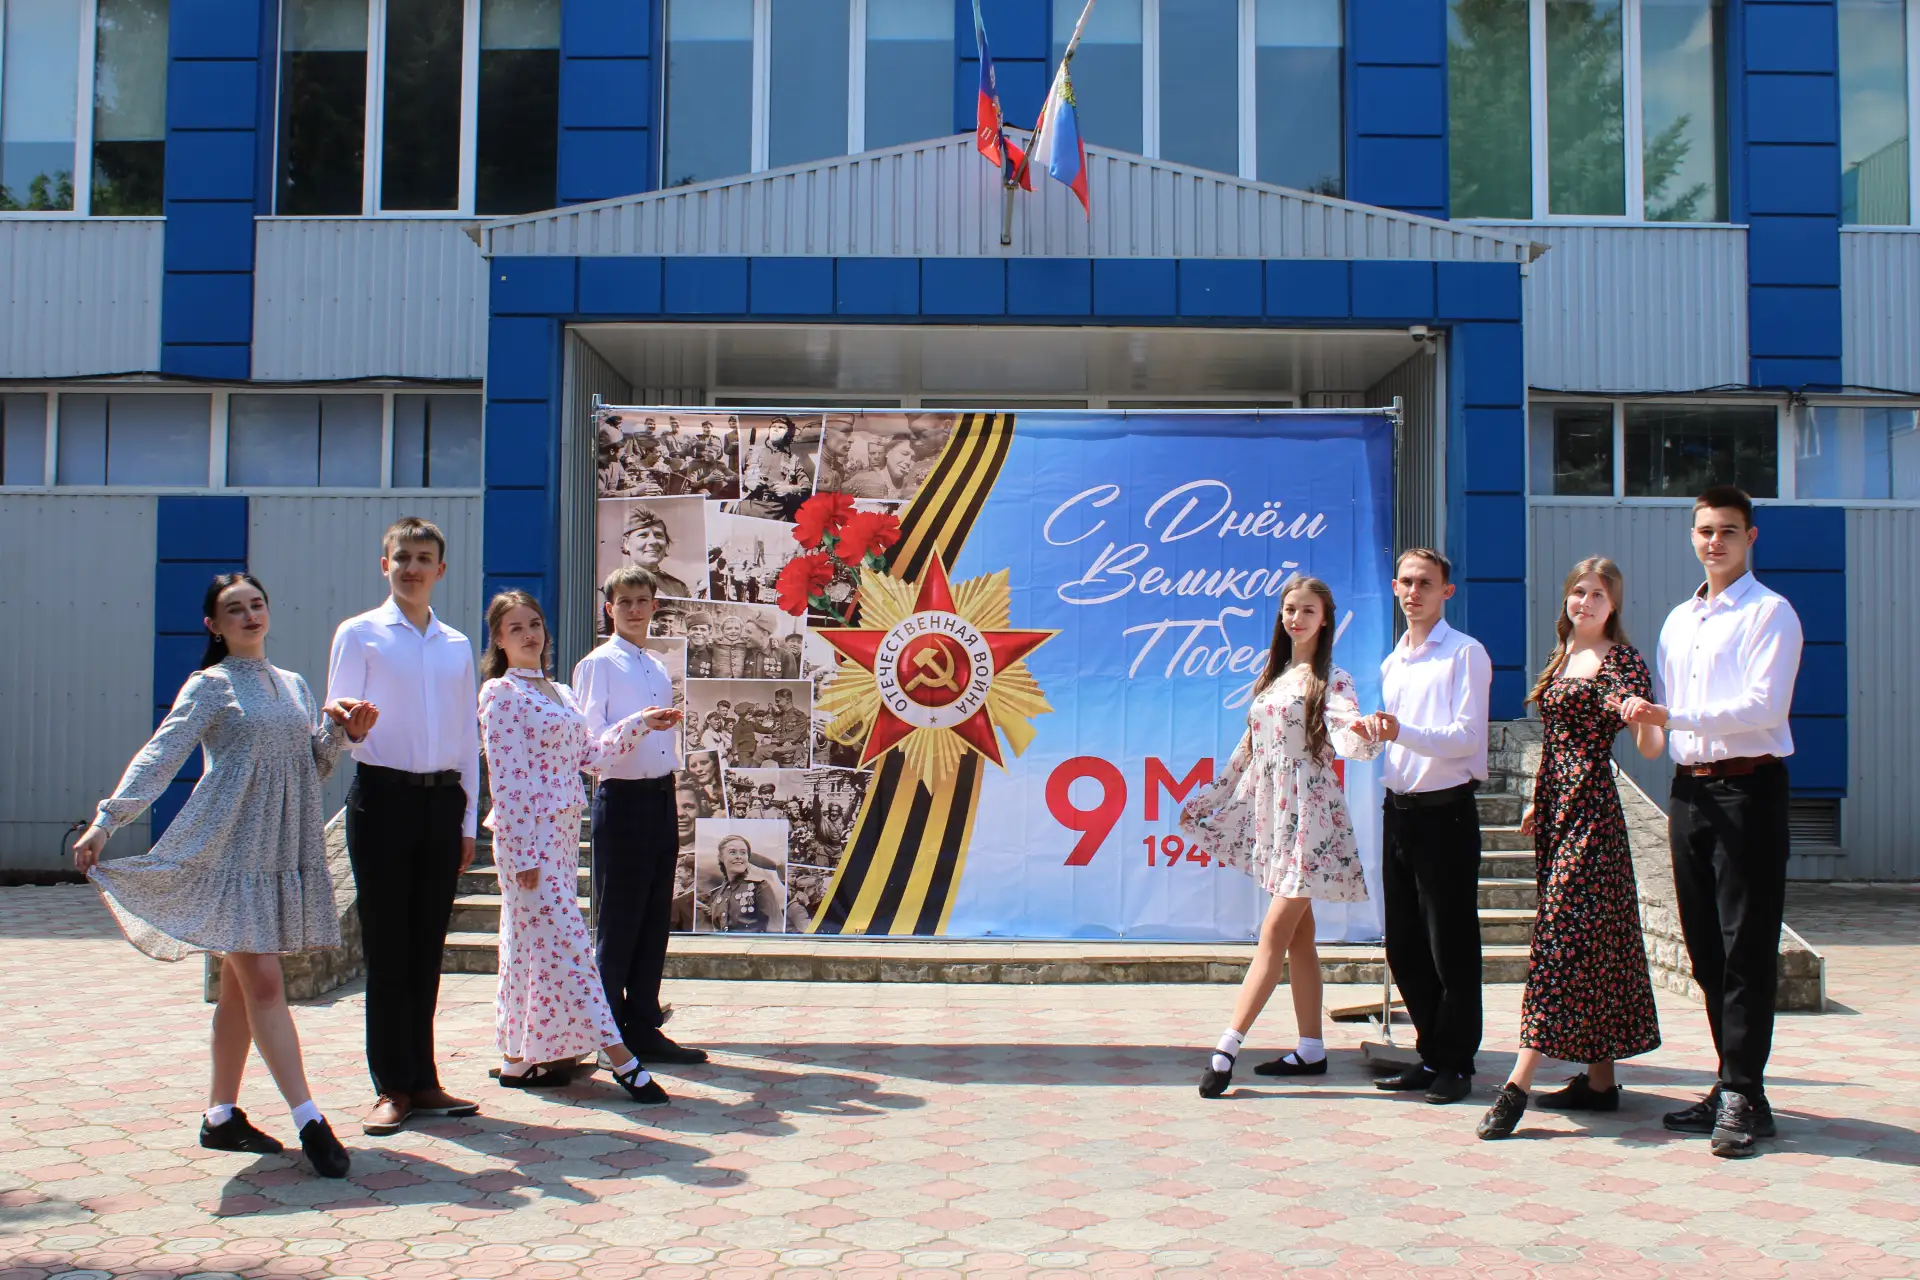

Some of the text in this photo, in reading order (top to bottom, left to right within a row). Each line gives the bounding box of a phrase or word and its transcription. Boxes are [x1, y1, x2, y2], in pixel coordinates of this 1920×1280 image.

[1043, 479, 1328, 545] С Днём
[1057, 542, 1299, 605] Великой
[879, 615, 990, 715] ОТЕЧЕСТВЕННАЯ ВОЙНА
[1122, 606, 1354, 710] Побед!
[1045, 756, 1128, 867] 9
[1142, 834, 1226, 868] 194
